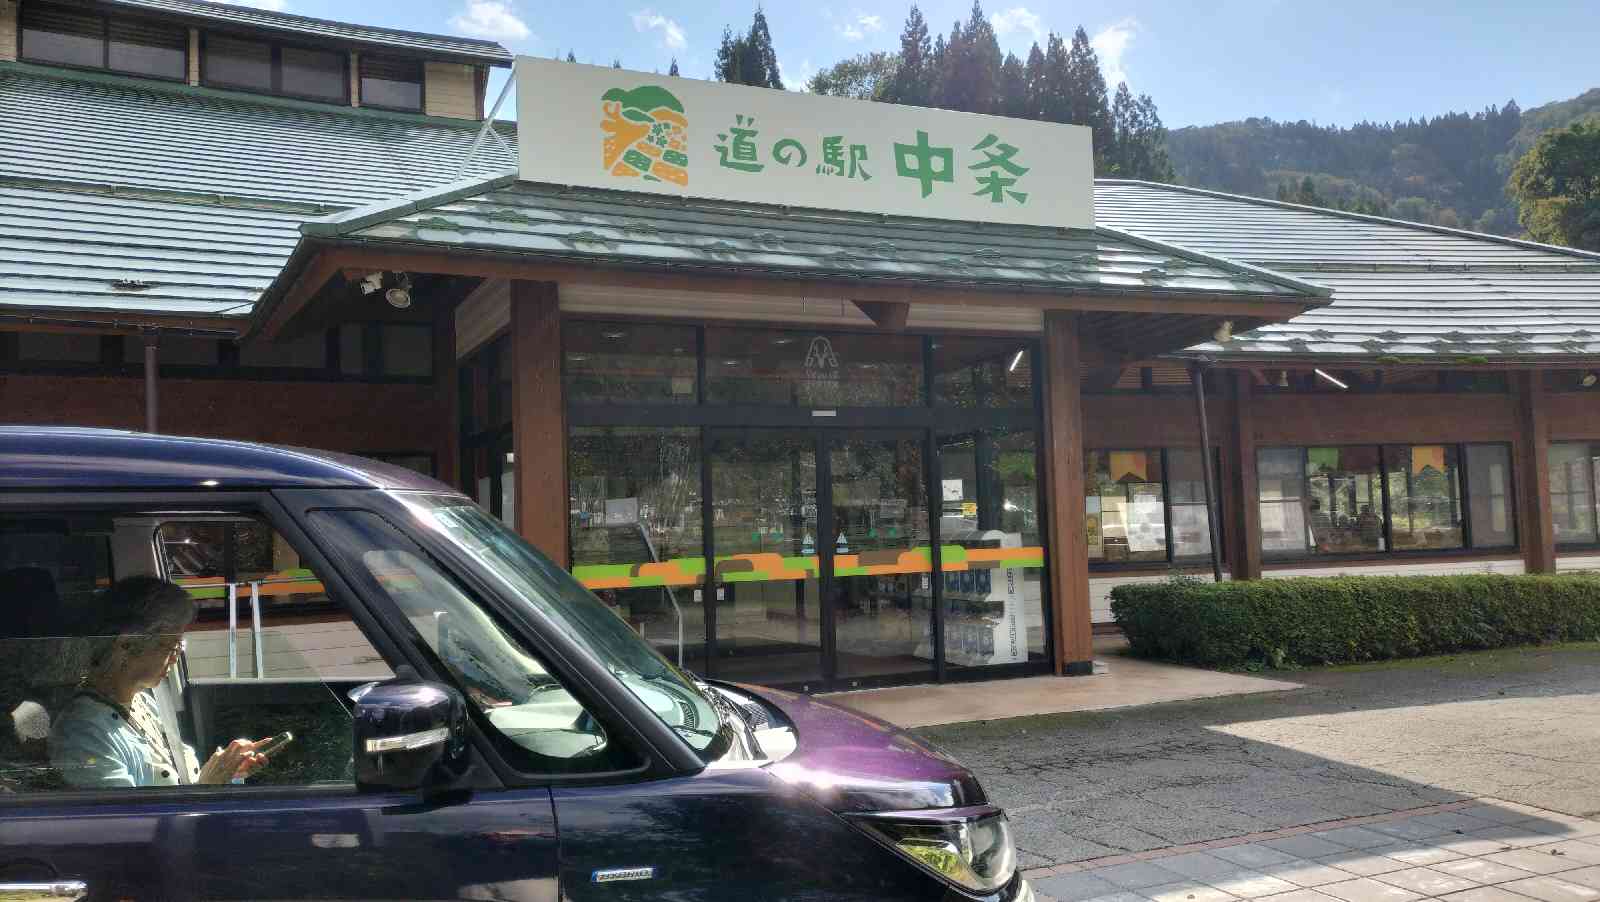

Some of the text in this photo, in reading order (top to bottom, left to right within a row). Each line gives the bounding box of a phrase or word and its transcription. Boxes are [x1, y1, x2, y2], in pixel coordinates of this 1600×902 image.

[713, 114, 1030, 204] 道の駅 中条
